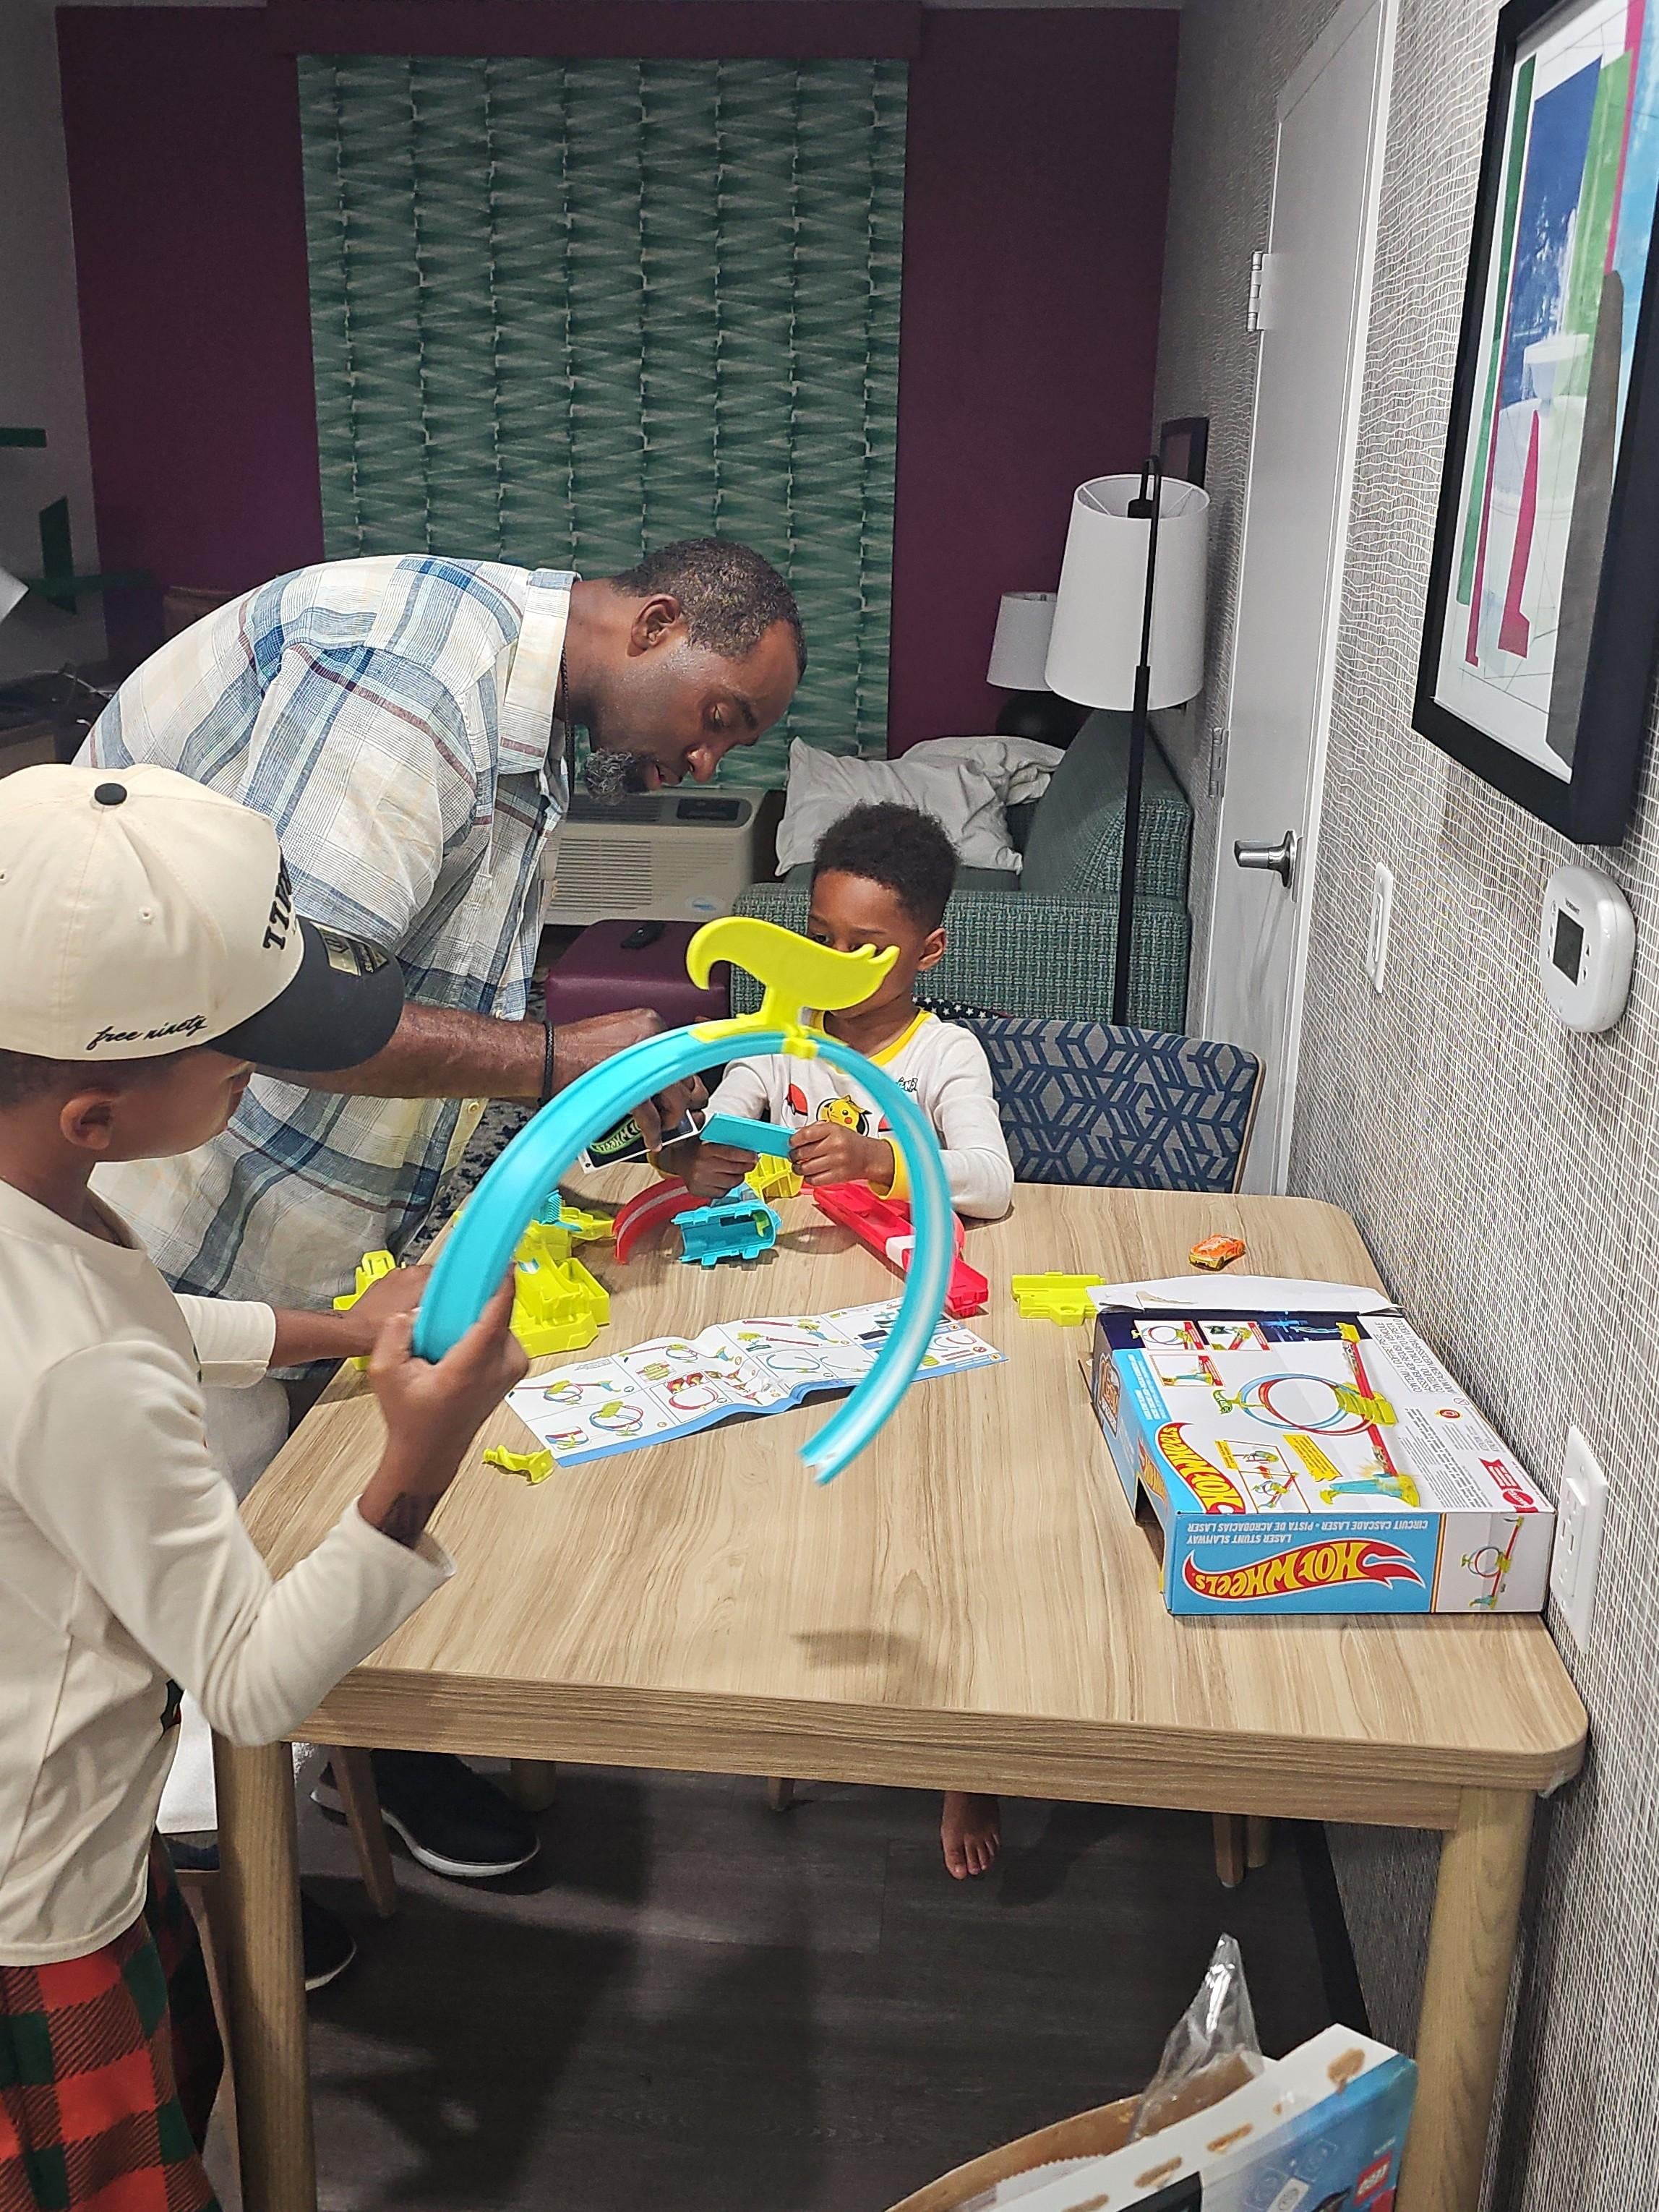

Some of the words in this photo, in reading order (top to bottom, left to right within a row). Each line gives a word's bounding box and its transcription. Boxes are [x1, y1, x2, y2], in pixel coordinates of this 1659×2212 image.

[86, 1026, 143, 1050] free
[144, 1015, 208, 1037] ninety
[1187, 1522, 1217, 1532] LASER
[1217, 1522, 1273, 1532] ACROBACIAS
[1273, 1522, 1287, 1531] DE
[1288, 1522, 1314, 1531] PISTA
[1321, 1521, 1350, 1531] LASER
[1351, 1520, 1392, 1530] CASCADE
[1393, 1520, 1428, 1530] CIRCUIT
[1186, 1535, 1230, 1545] SLAMWAY
[1231, 1534, 1261, 1543] STUNT
[1264, 1534, 1292, 1543] LASER
